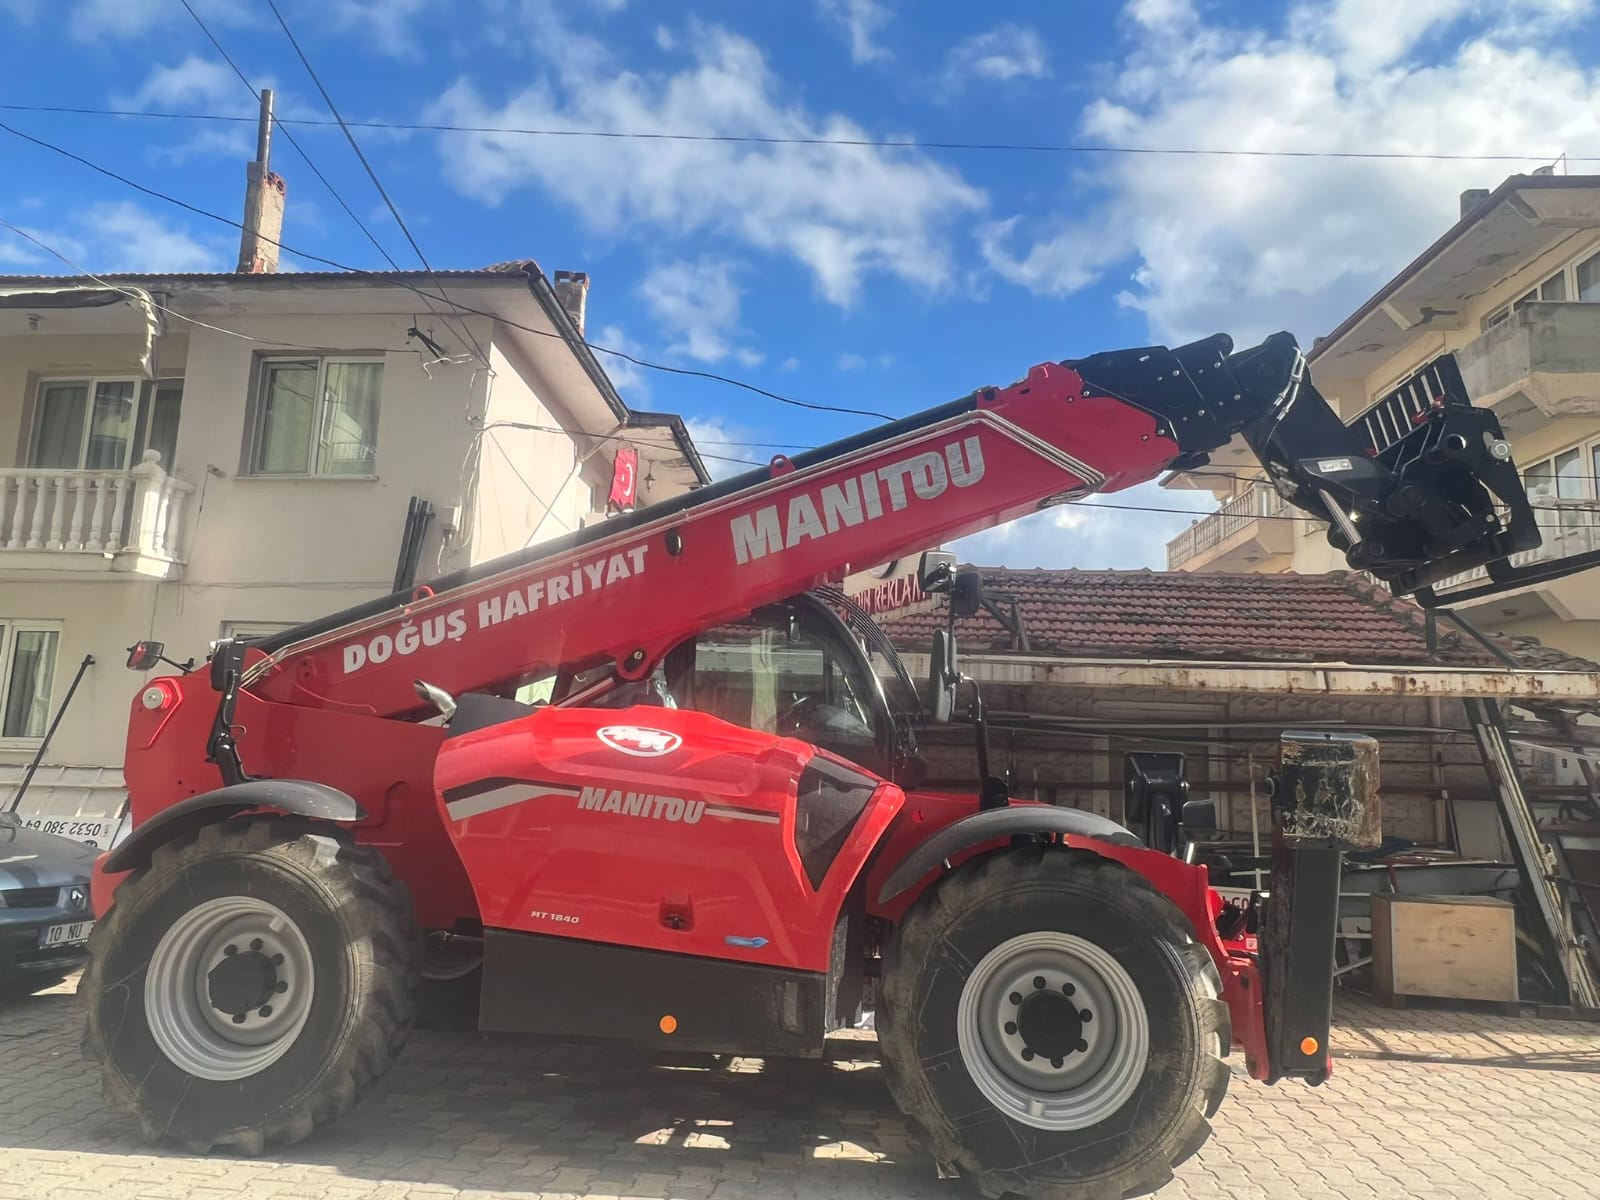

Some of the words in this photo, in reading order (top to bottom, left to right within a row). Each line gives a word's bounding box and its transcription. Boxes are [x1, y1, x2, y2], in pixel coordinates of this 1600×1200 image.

[730, 435, 985, 565] MANITOU
[344, 609, 467, 674] DOĞUŞ
[478, 545, 648, 629] HAFRİYAT
[577, 786, 705, 824] MANITOU
[43, 820, 70, 835] 380
[69, 821, 102, 836] 0532
[530, 910, 548, 920] MT
[549, 913, 580, 924] 1840
[50, 926, 62, 942] 10
